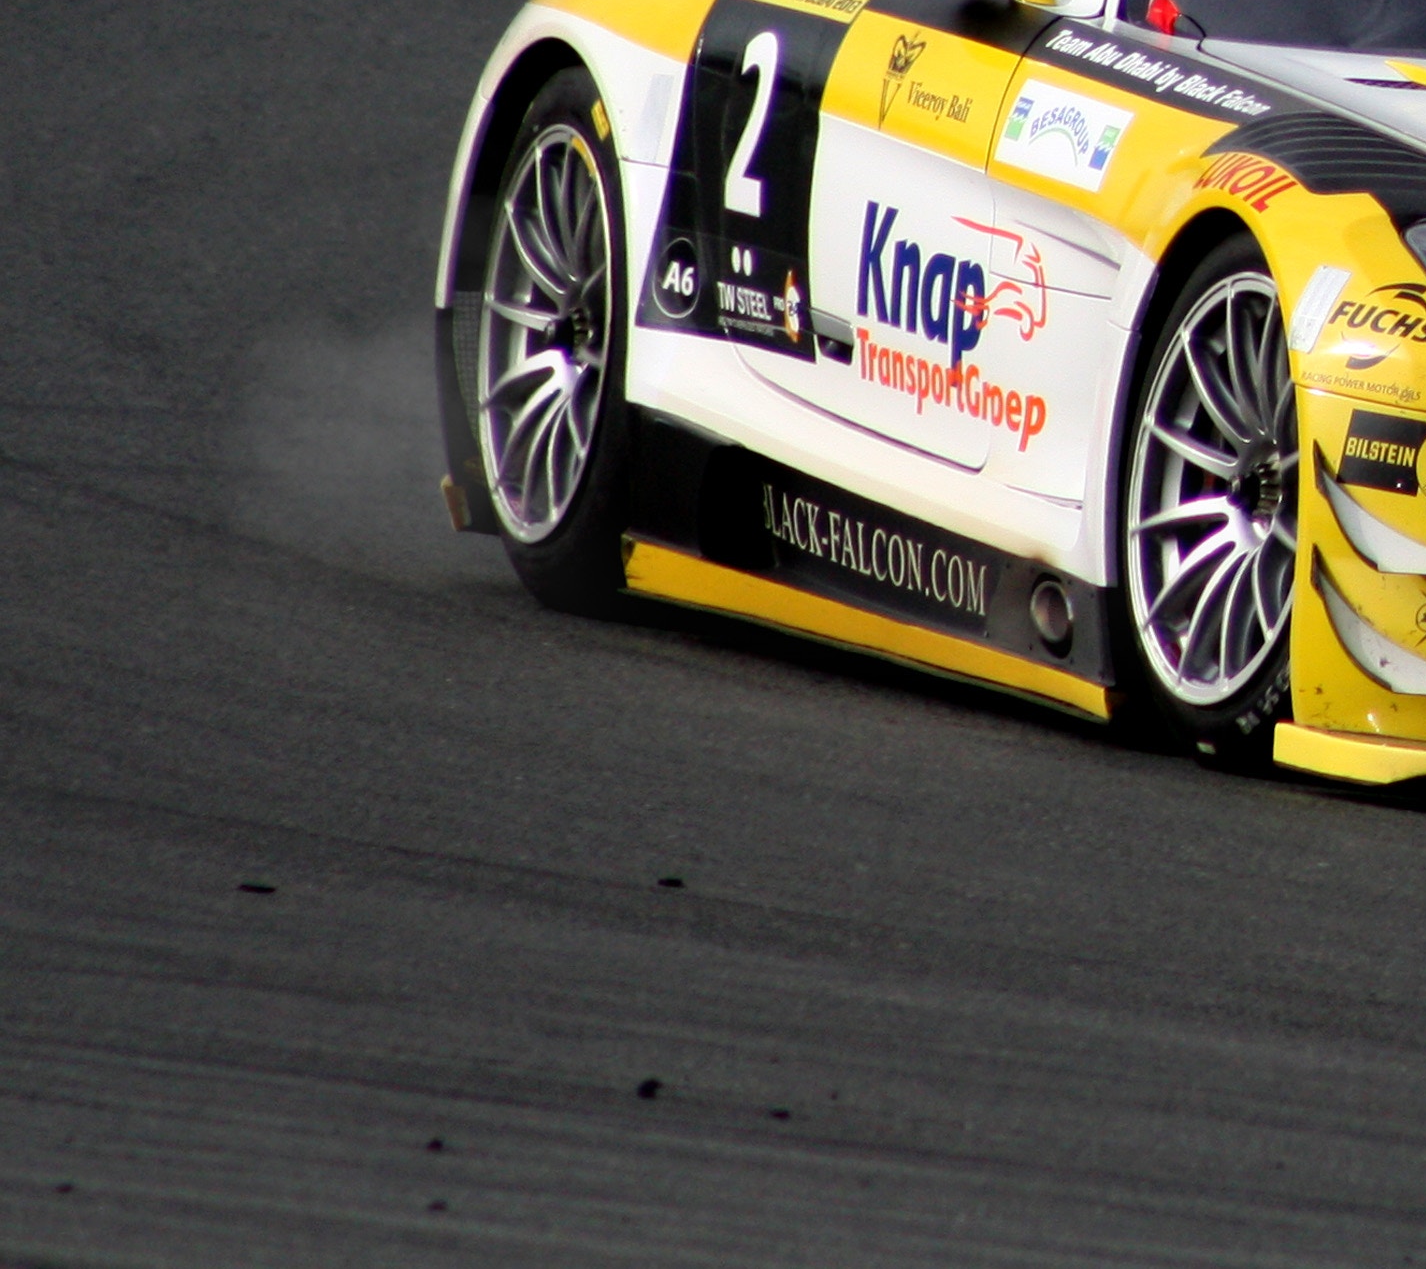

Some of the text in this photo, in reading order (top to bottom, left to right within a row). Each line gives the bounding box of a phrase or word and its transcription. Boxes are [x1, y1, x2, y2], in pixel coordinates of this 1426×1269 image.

[1045, 29, 1272, 116] Team Abu Dhabi by Black Falcon
[724, 31, 779, 218] 2
[907, 81, 974, 123] Viceroy Bali
[1030, 105, 1090, 155] BESAGROUP
[1193, 152, 1298, 214] LUKOIL
[661, 261, 695, 297] A6
[717, 282, 736, 313] TW
[737, 287, 772, 321] STEEL
[857, 200, 986, 388] Knap
[1301, 370, 1333, 385] RACING
[1334, 374, 1365, 391] POWER
[1366, 382, 1400, 397] MOTOR
[1345, 437, 1416, 468] BILSTEIN
